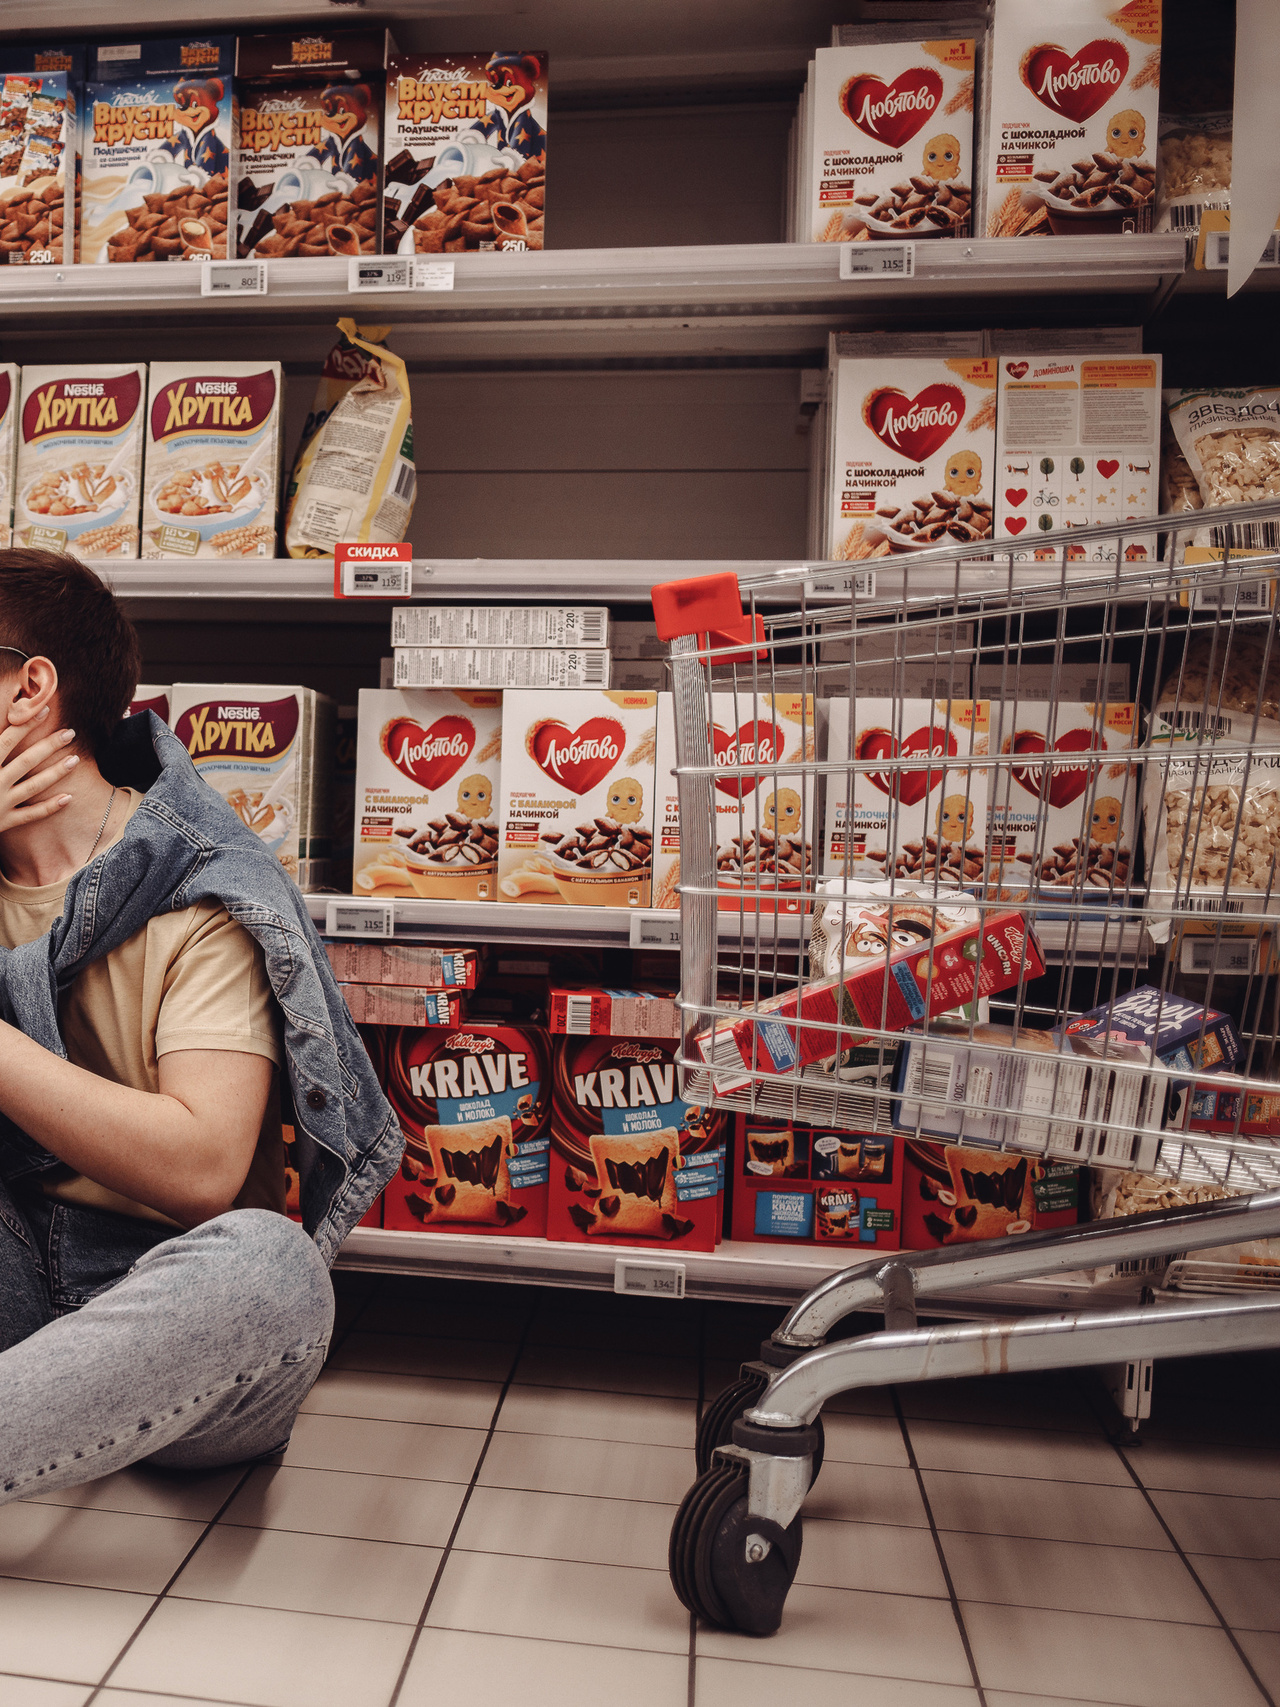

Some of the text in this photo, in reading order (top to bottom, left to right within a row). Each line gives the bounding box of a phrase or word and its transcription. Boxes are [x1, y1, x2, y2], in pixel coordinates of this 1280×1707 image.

[1037, 58, 1121, 107] Любятово
[856, 85, 936, 134] Любятово
[1002, 127, 1086, 140] С ШОКОЛАДНОЙ
[1001, 139, 1056, 150] НАЧИНКОЙ
[824, 153, 904, 167] С ШОКОЛАДНОЙ
[823, 165, 875, 177] НАЧИНКОЙ
[882, 260, 898, 269] 115
[1033, 365, 1075, 378] ДОМИНОШКА
[34, 385, 119, 434] ХРУТКА
[163, 382, 253, 432] ХРУТКА
[878, 401, 958, 447] Любятово
[846, 466, 925, 478] С ШОКОЛАДНОЙ
[846, 477, 897, 487] НАЧИНКОЙ
[347, 546, 399, 560] СКИДКА
[566, 612, 575, 629] 220
[568, 653, 577, 670] 220
[624, 697, 648, 705] НОВИНКА
[189, 706, 275, 756] ХРУТКА
[395, 733, 468, 775] Любятово
[542, 734, 618, 779] Любятово
[365, 794, 429, 805] С БАНАНОВОЙ
[510, 798, 577, 810] С БАНАНОВОЙ
[365, 804, 412, 814] НАЧИНКОЙ
[509, 808, 559, 819] НАЧИНКОЙ
[575, 876, 611, 884] НАТУРАЛЬНЫМ
[364, 920, 379, 929] 115
[986, 934, 1012, 975] UNICORN
[454, 951, 466, 986] KRAVE
[437, 991, 450, 1026] KRAVE
[558, 1014, 566, 1028] 220
[445, 1033, 495, 1053] Kellogg's
[611, 1042, 662, 1063] Kellogg's
[409, 1052, 530, 1099] KRAVE
[574, 1063, 677, 1109] KRAV
[459, 1099, 491, 1112] ШОКОЛАД
[457, 1108, 495, 1122] И МОЛОКО
[625, 1110, 657, 1121] ШОКОЛАД
[623, 1119, 662, 1132] И МОЛОКО
[821, 1193, 854, 1206] KRAVE
